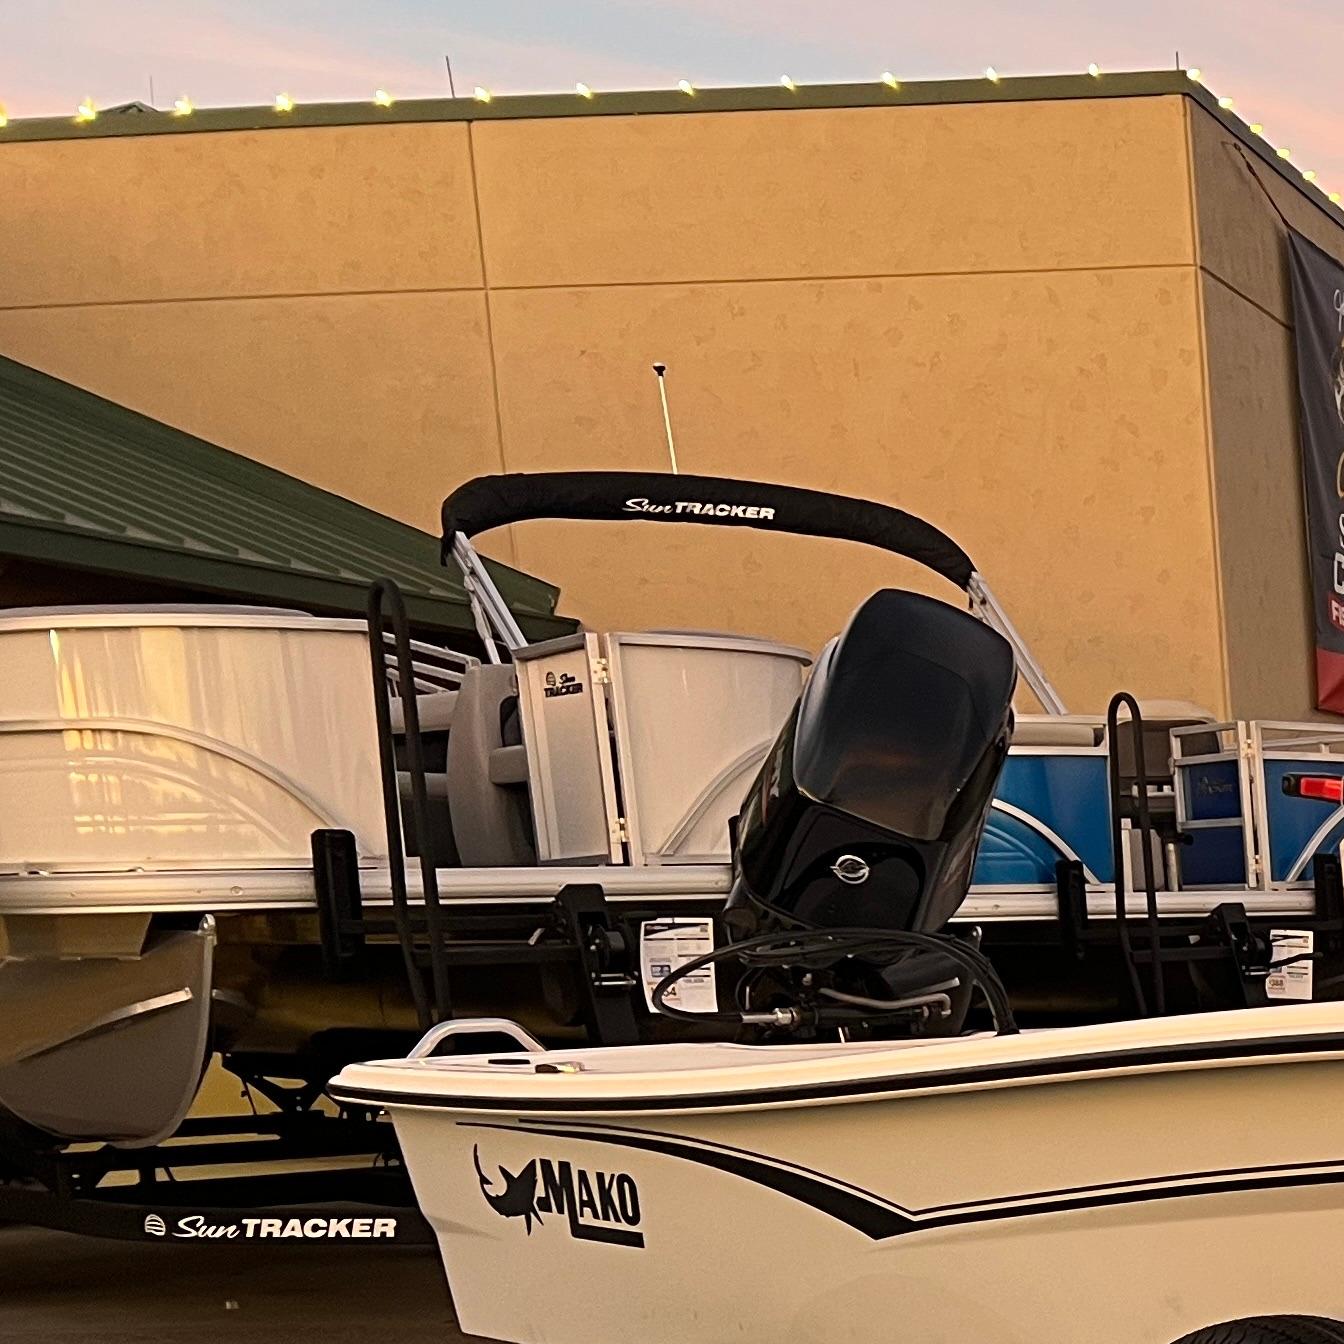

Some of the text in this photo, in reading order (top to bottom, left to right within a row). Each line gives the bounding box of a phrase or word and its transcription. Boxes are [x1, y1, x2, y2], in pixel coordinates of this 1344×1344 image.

[622, 497, 776, 520] Sun TRACKER
[535, 1157, 646, 1249] MAKO
[171, 1215, 397, 1239] Sun TRACKER
